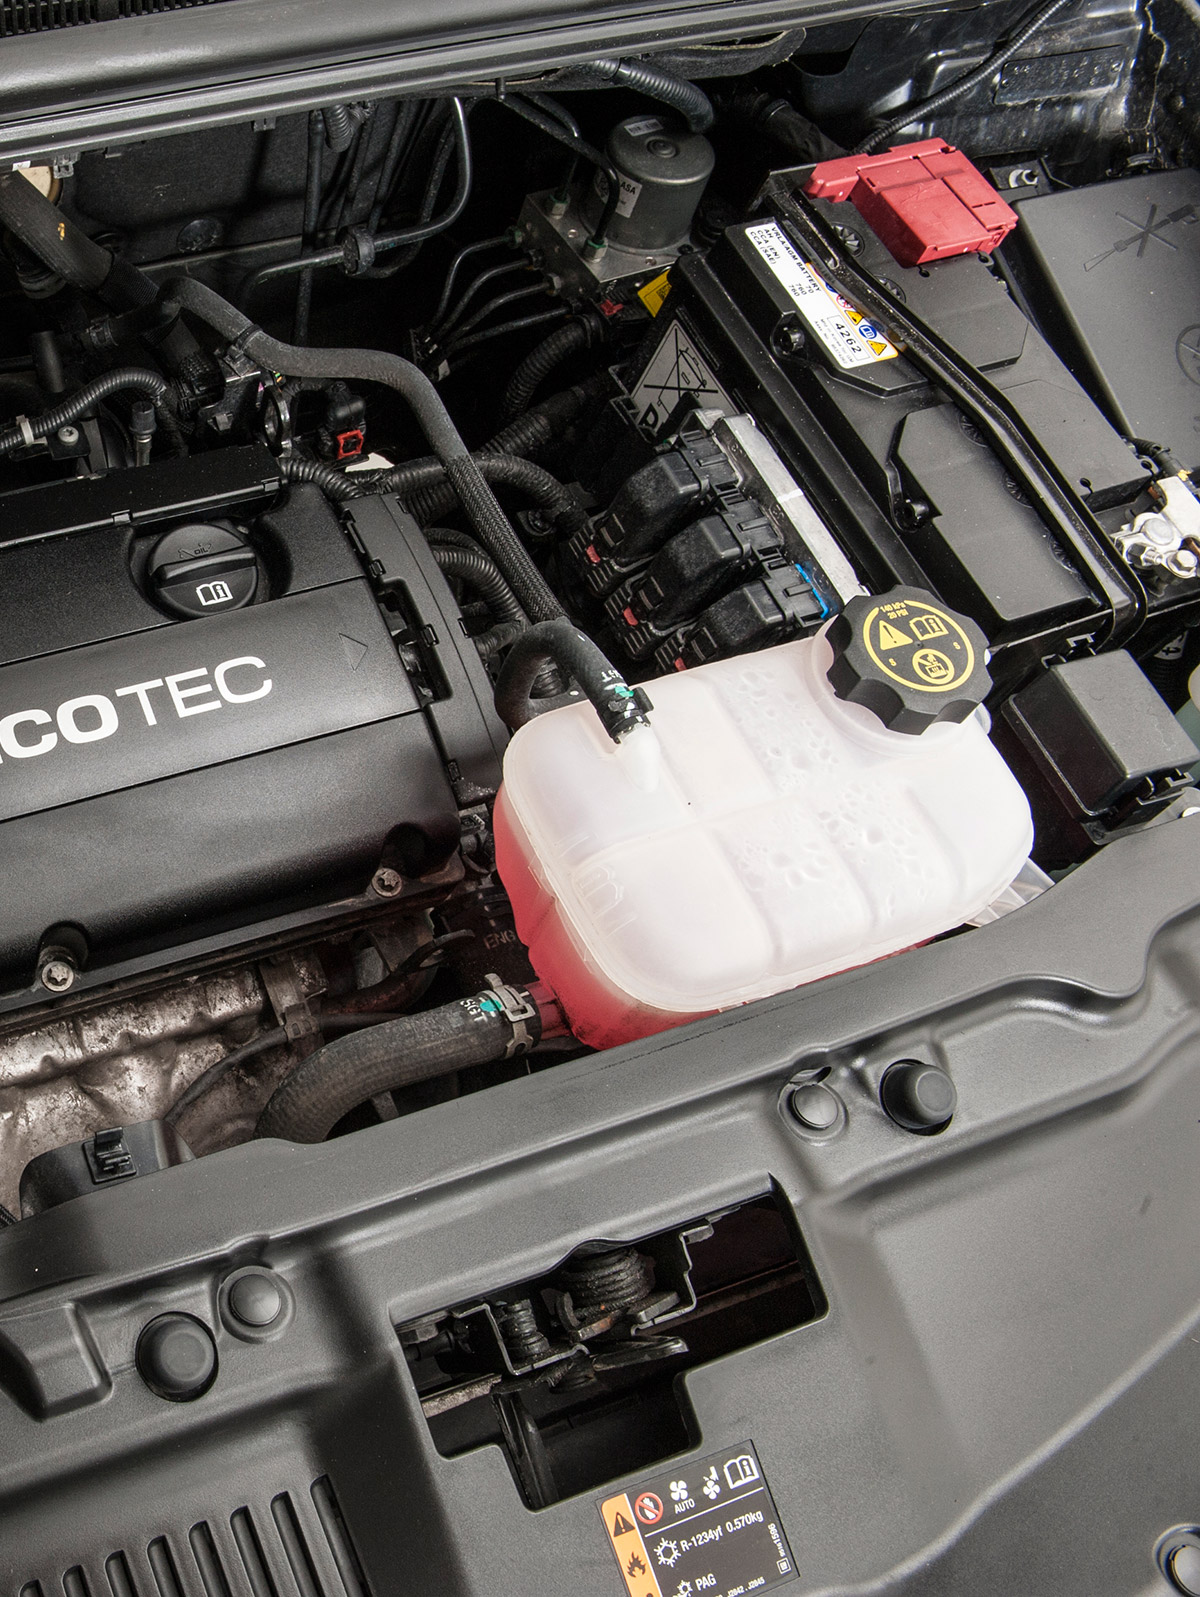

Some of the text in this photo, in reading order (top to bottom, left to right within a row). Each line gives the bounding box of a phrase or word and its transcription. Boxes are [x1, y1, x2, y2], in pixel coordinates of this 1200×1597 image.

[750, 231, 762, 246] CCA
[757, 230, 768, 244] CCA
[796, 262, 822, 292] BATTERY
[834, 322, 862, 354] 4262
[674, 1498, 696, 1514] AUTO
[680, 1510, 764, 1552] R-1234yf 0.570kg
[695, 1573, 717, 1591] PAG
